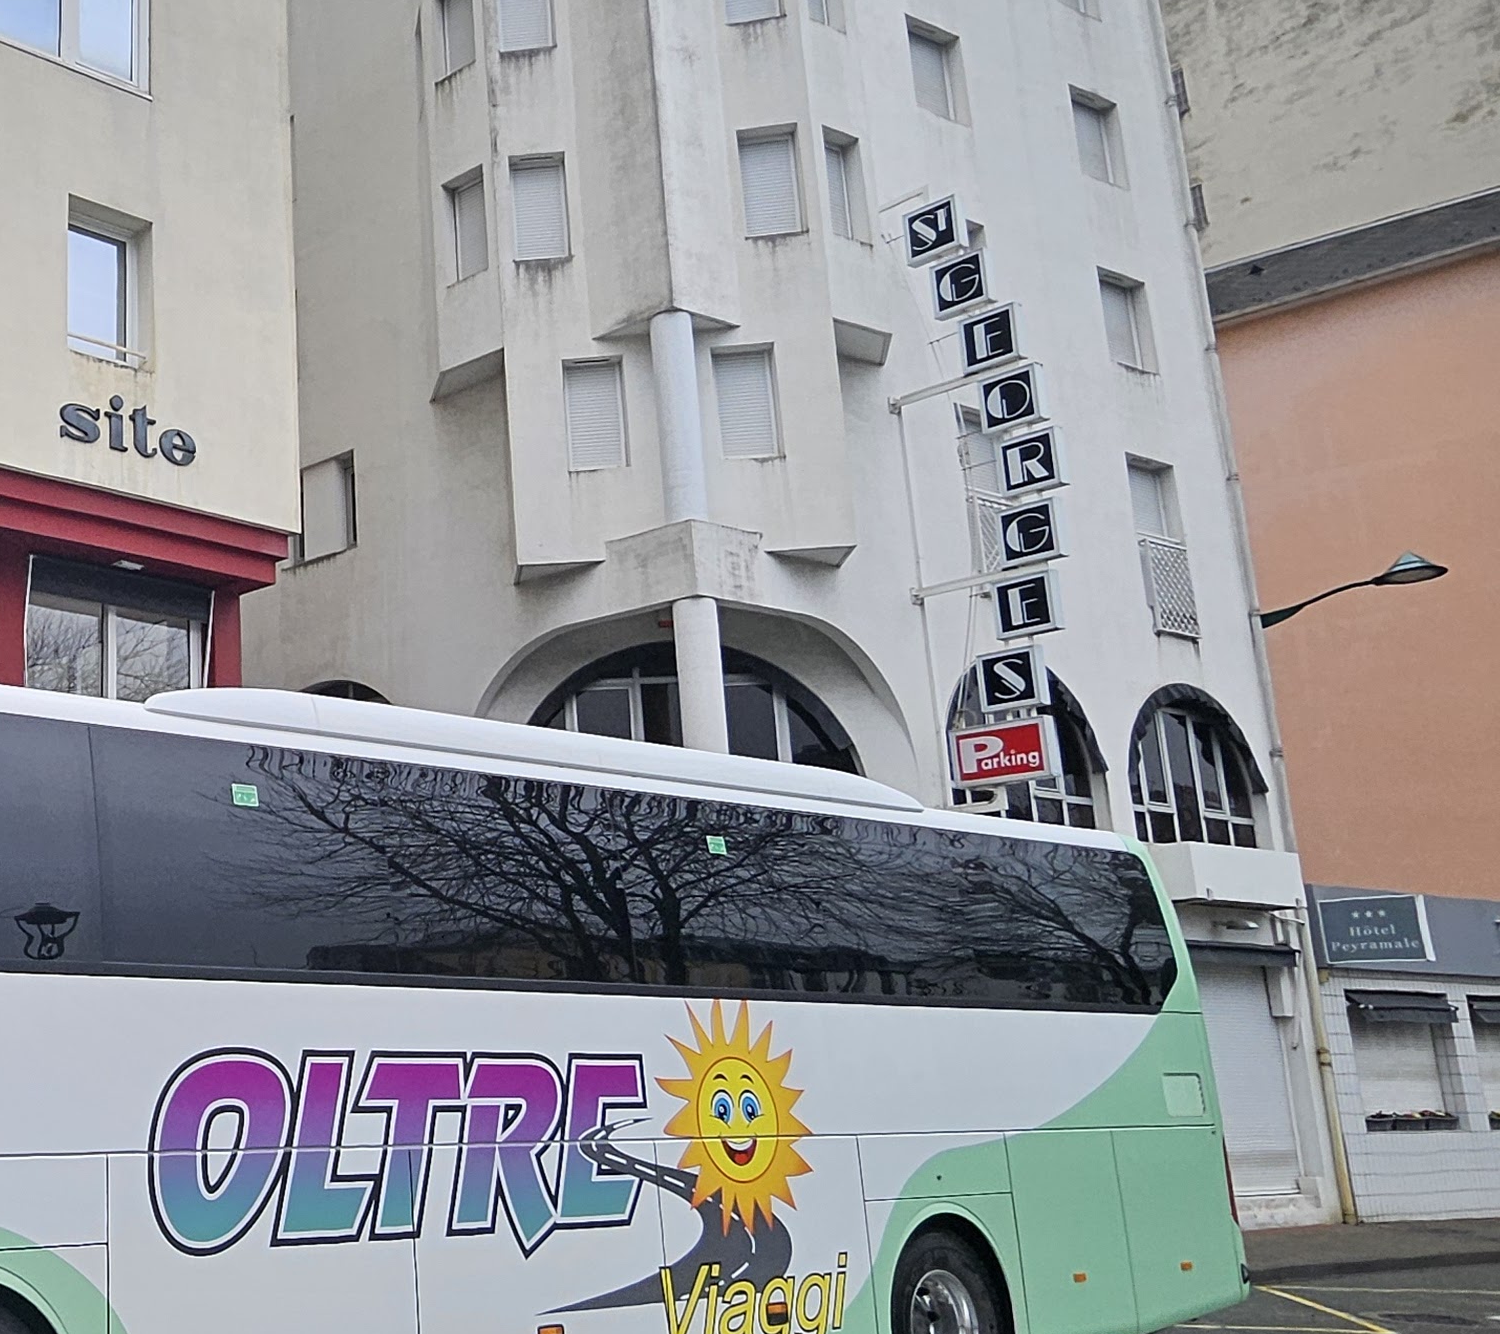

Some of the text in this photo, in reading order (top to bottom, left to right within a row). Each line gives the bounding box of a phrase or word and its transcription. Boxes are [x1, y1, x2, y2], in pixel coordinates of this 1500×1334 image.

[59, 394, 198, 467] site
[938, 263, 1052, 700] GEORGES
[958, 734, 1041, 775] Parking
[1330, 937, 1421, 953] Peyramale
[1348, 923, 1397, 937] Hôtel
[148, 1046, 648, 1260] OLTRE
